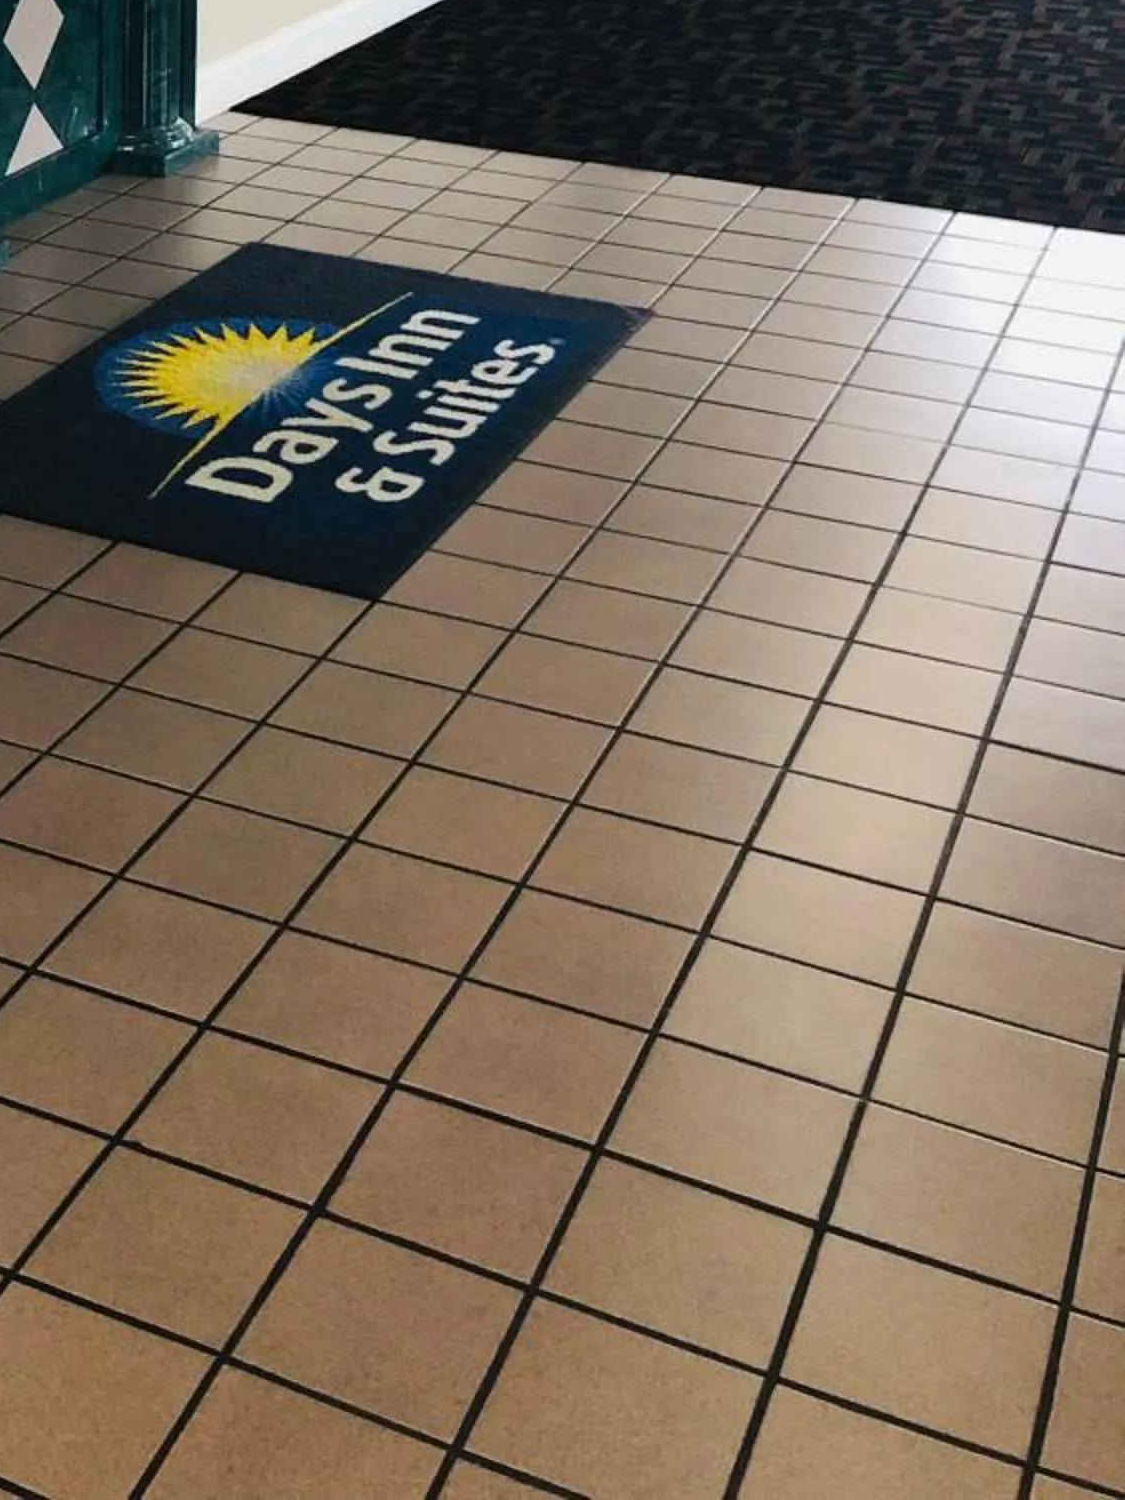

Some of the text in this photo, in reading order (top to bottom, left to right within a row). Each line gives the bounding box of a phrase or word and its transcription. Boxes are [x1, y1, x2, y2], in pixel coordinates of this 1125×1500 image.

[185, 309, 481, 503] Days Inn
[335, 339, 557, 503] & Suites
